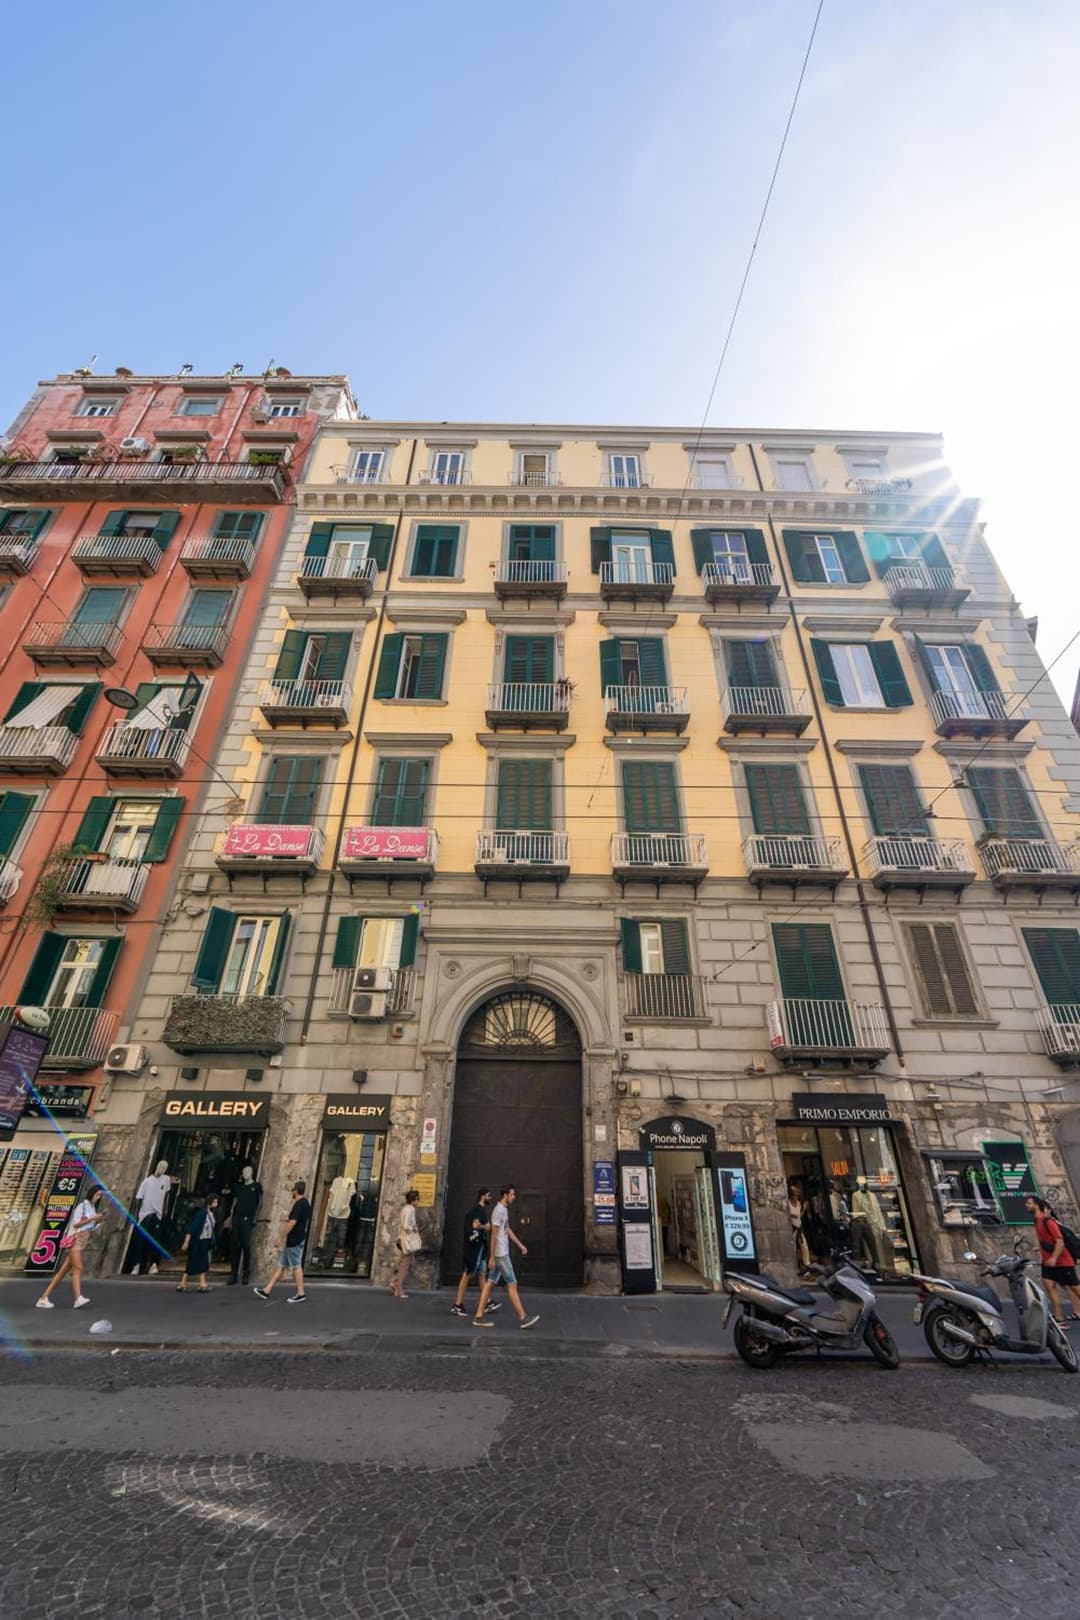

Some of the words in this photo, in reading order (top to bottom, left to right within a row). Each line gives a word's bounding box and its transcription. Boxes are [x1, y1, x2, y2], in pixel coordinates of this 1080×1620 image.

[236, 833, 261, 853] La
[263, 833, 304, 851] Danse
[356, 835, 380, 854] La
[382, 835, 424, 853] Danse
[166, 1101, 263, 1116] GALLERY
[327, 1106, 385, 1116] GALLERY
[799, 1107, 837, 1119] PRIMO
[838, 1108, 892, 1120] EMPORIO
[649, 1133, 677, 1143] Phone
[679, 1133, 707, 1145] Napoli
